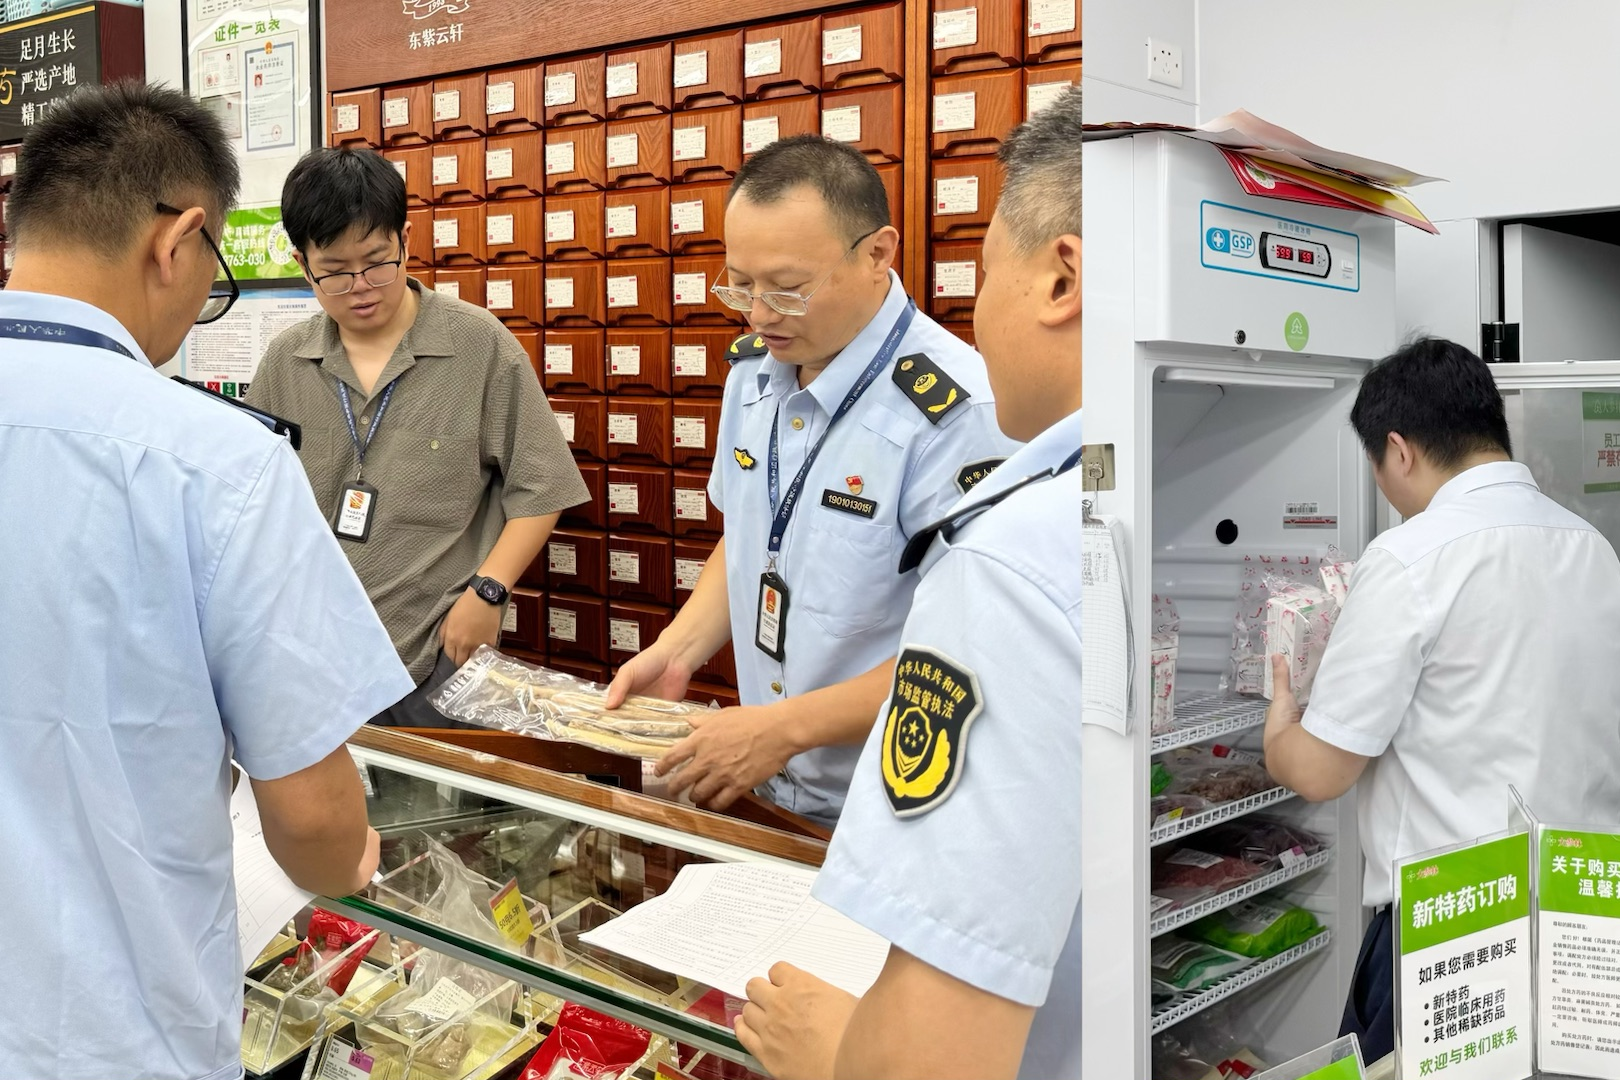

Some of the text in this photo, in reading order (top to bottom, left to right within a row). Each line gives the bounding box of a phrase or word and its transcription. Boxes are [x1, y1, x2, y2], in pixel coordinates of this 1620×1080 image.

[19, 28, 77, 63] 足月生长
[408, 22, 464, 51] 东紫云轩
[19, 62, 77, 96] 严选产地
[1231, 234, 1253, 250] GSP
[897, 660, 967, 704] 中华人民共和国
[897, 678, 955, 720] 市场监管执法
[1411, 873, 1518, 930] 新特药订购
[1417, 937, 1518, 986] 如果您需要购买
[1432, 984, 1471, 1010] 新特药
[1432, 987, 1507, 1027] 医院临床用药
[1432, 1004, 1506, 1043] 其他稀缺药品
[1418, 1025, 1519, 1078] 欢迎与我们联系
